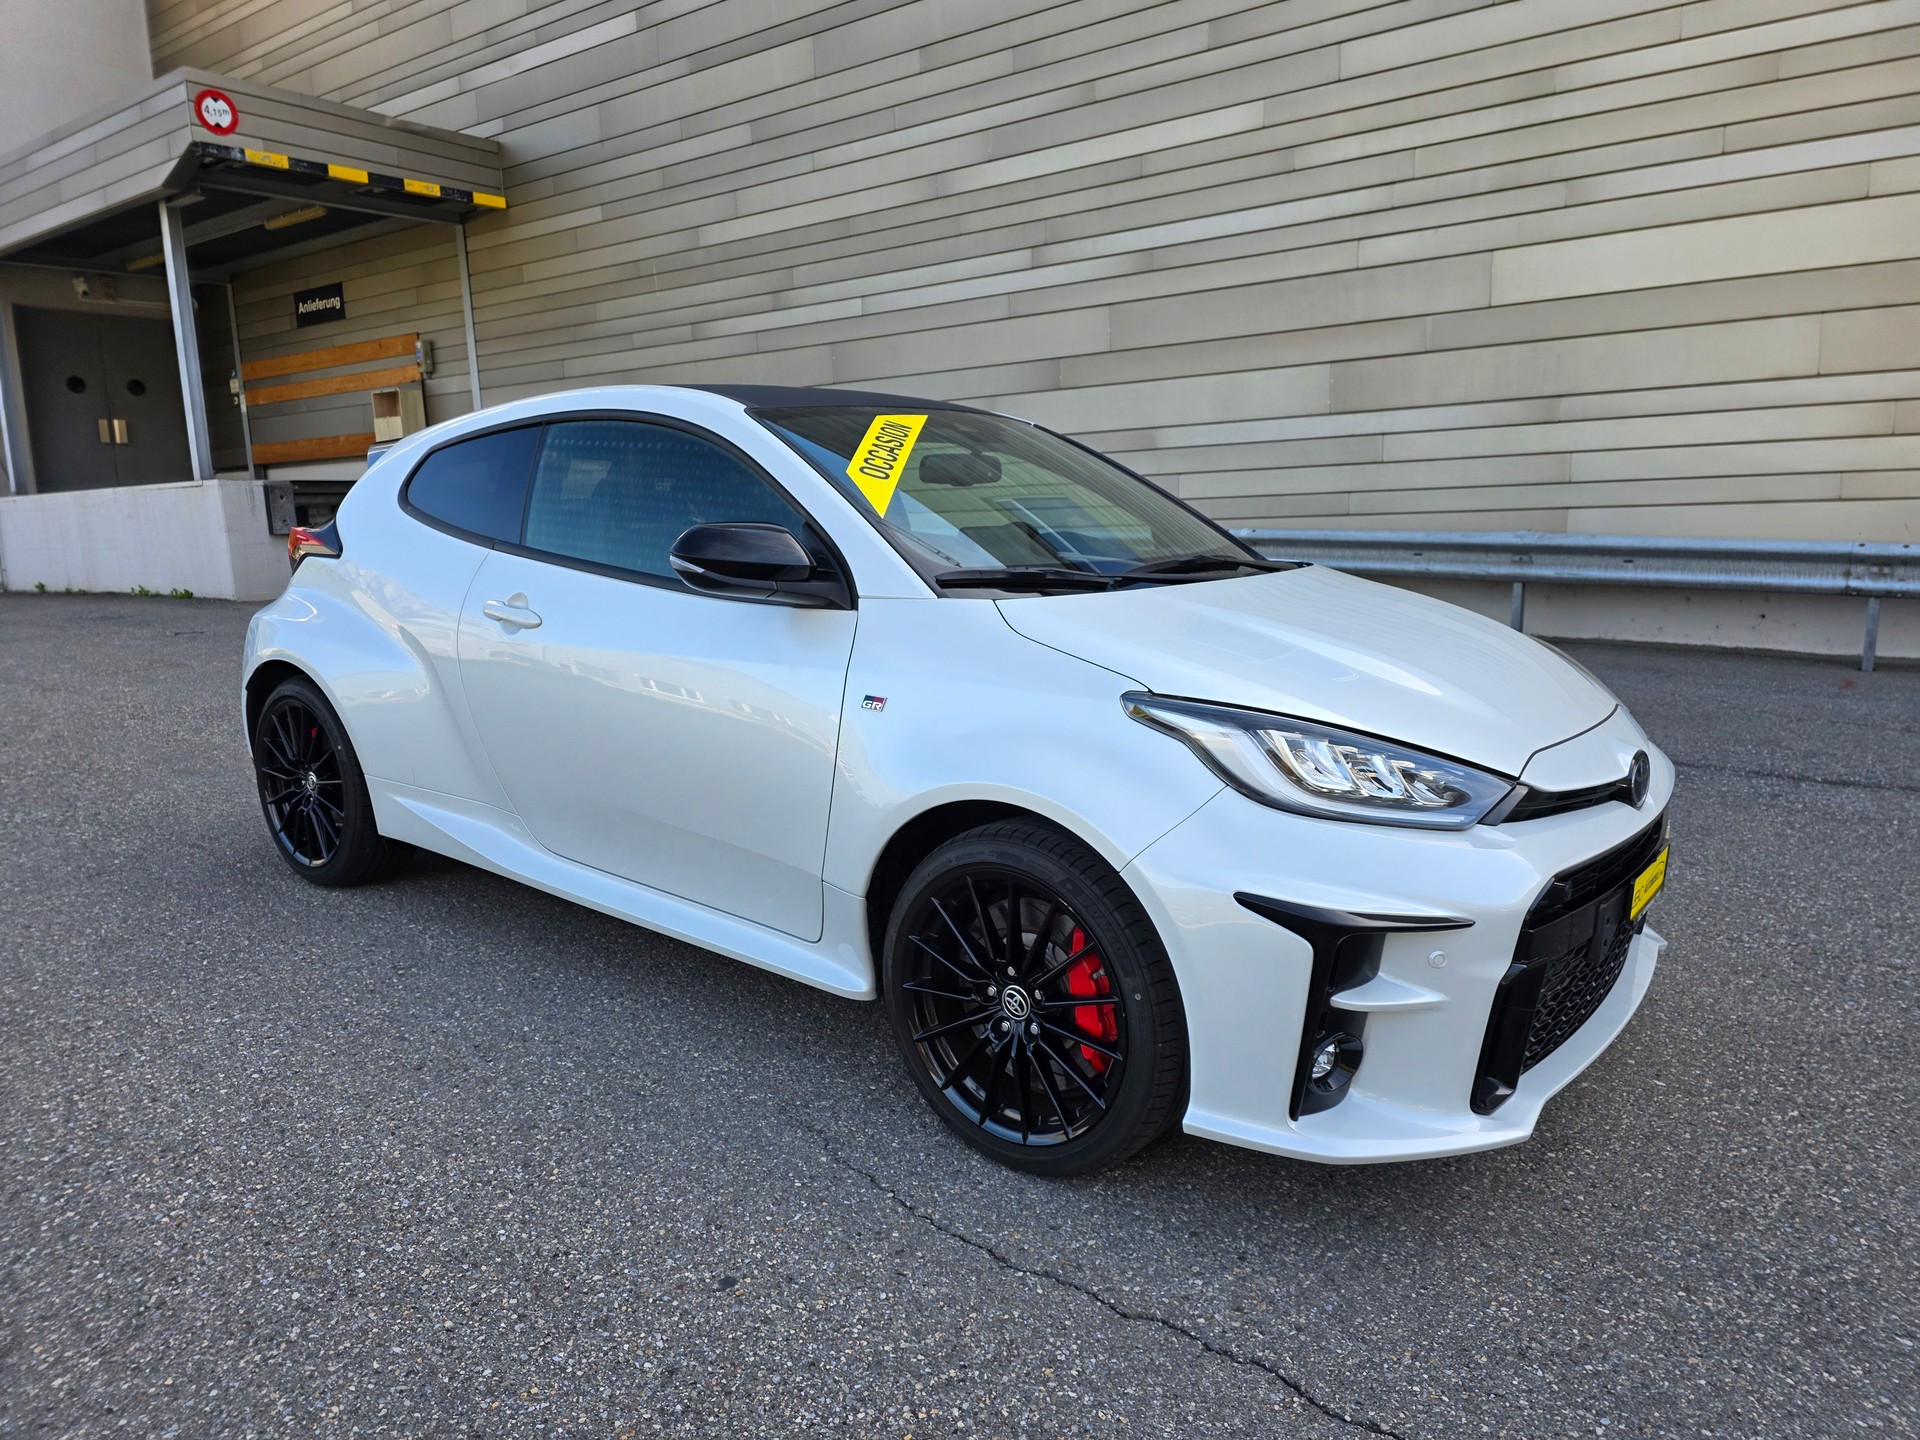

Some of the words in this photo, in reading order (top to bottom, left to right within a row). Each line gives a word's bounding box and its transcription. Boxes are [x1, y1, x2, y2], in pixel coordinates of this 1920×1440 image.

[298, 296, 341, 314] Anlieferung
[858, 419, 912, 480] OCCASION
[862, 700, 882, 711] GR
